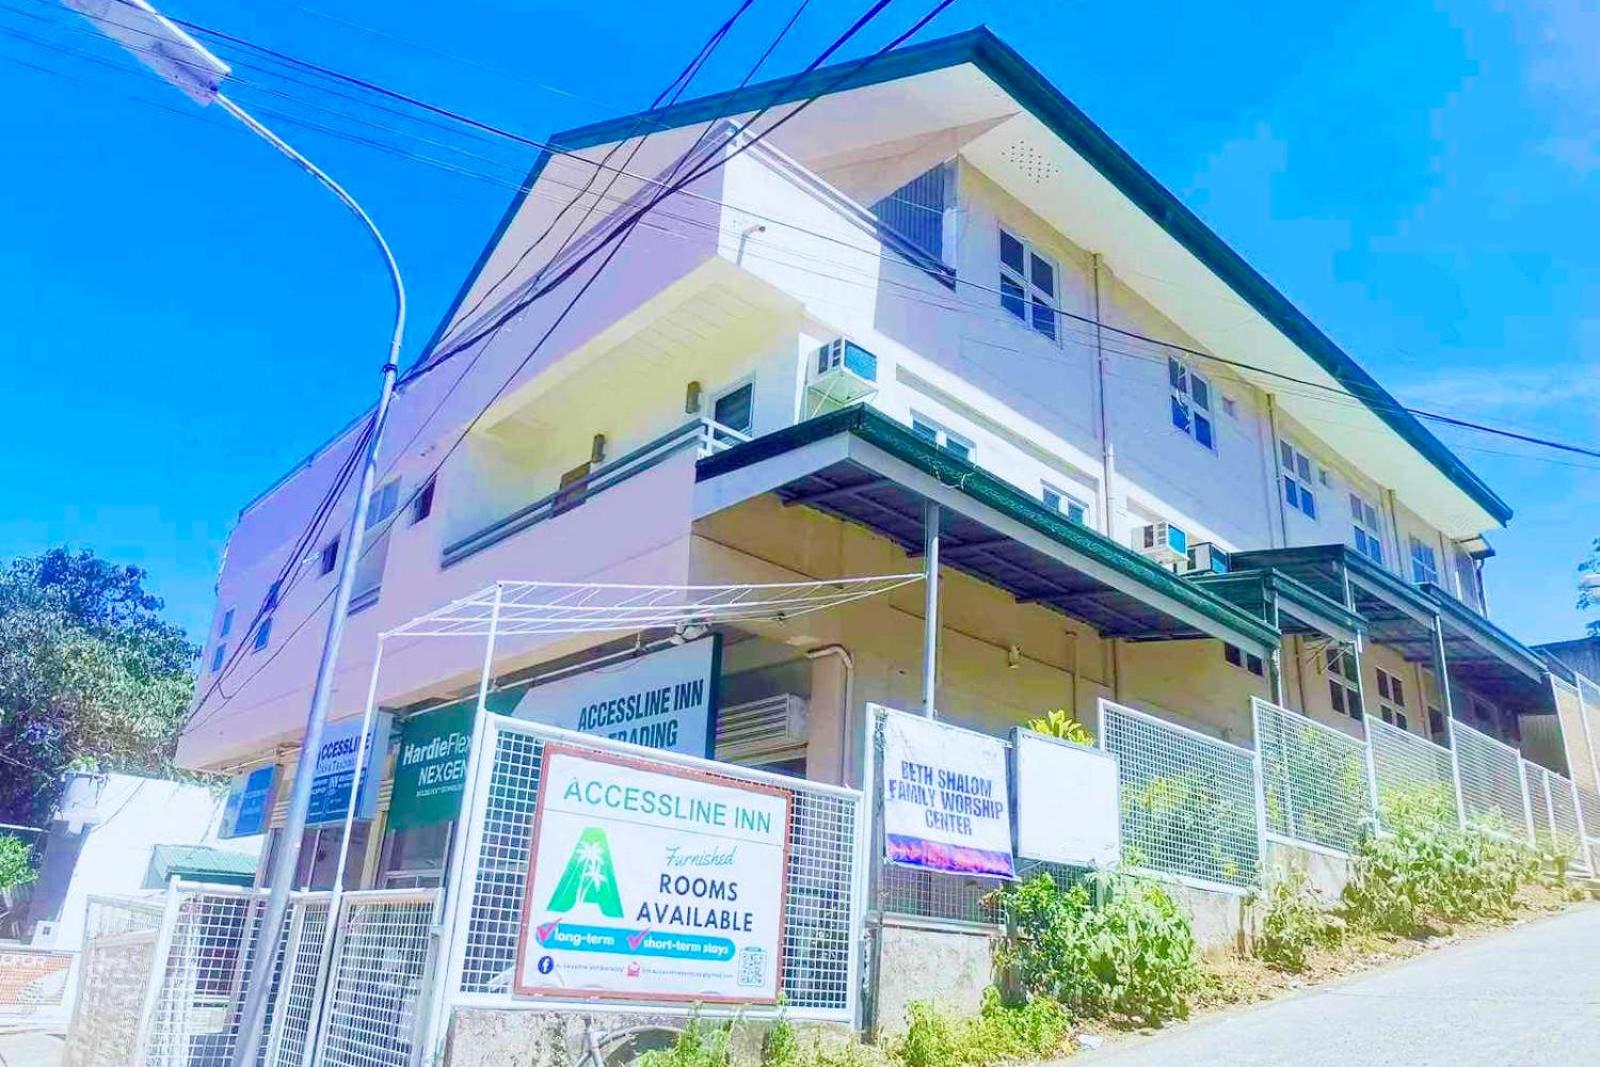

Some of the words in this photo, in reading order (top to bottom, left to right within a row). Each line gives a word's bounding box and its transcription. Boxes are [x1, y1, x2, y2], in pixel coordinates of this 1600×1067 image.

[577, 688, 669, 731] ACCESSLINE
[673, 679, 704, 711] INN
[607, 720, 678, 749] ADING
[901, 760, 933, 784] BETH
[938, 769, 993, 798] SHALOM
[563, 777, 728, 826] ACCESSLINE
[735, 807, 772, 833] INN
[889, 780, 936, 807] FAMILY
[941, 791, 1004, 820] WORSHIP
[925, 810, 972, 834] CENTER
[664, 844, 737, 868] Furnished
[659, 873, 738, 901] ROOMS
[636, 902, 754, 932] AVAILABLE
[554, 929, 615, 946] long-term
[643, 937, 701, 953] short-term
[702, 943, 729, 956] stays
